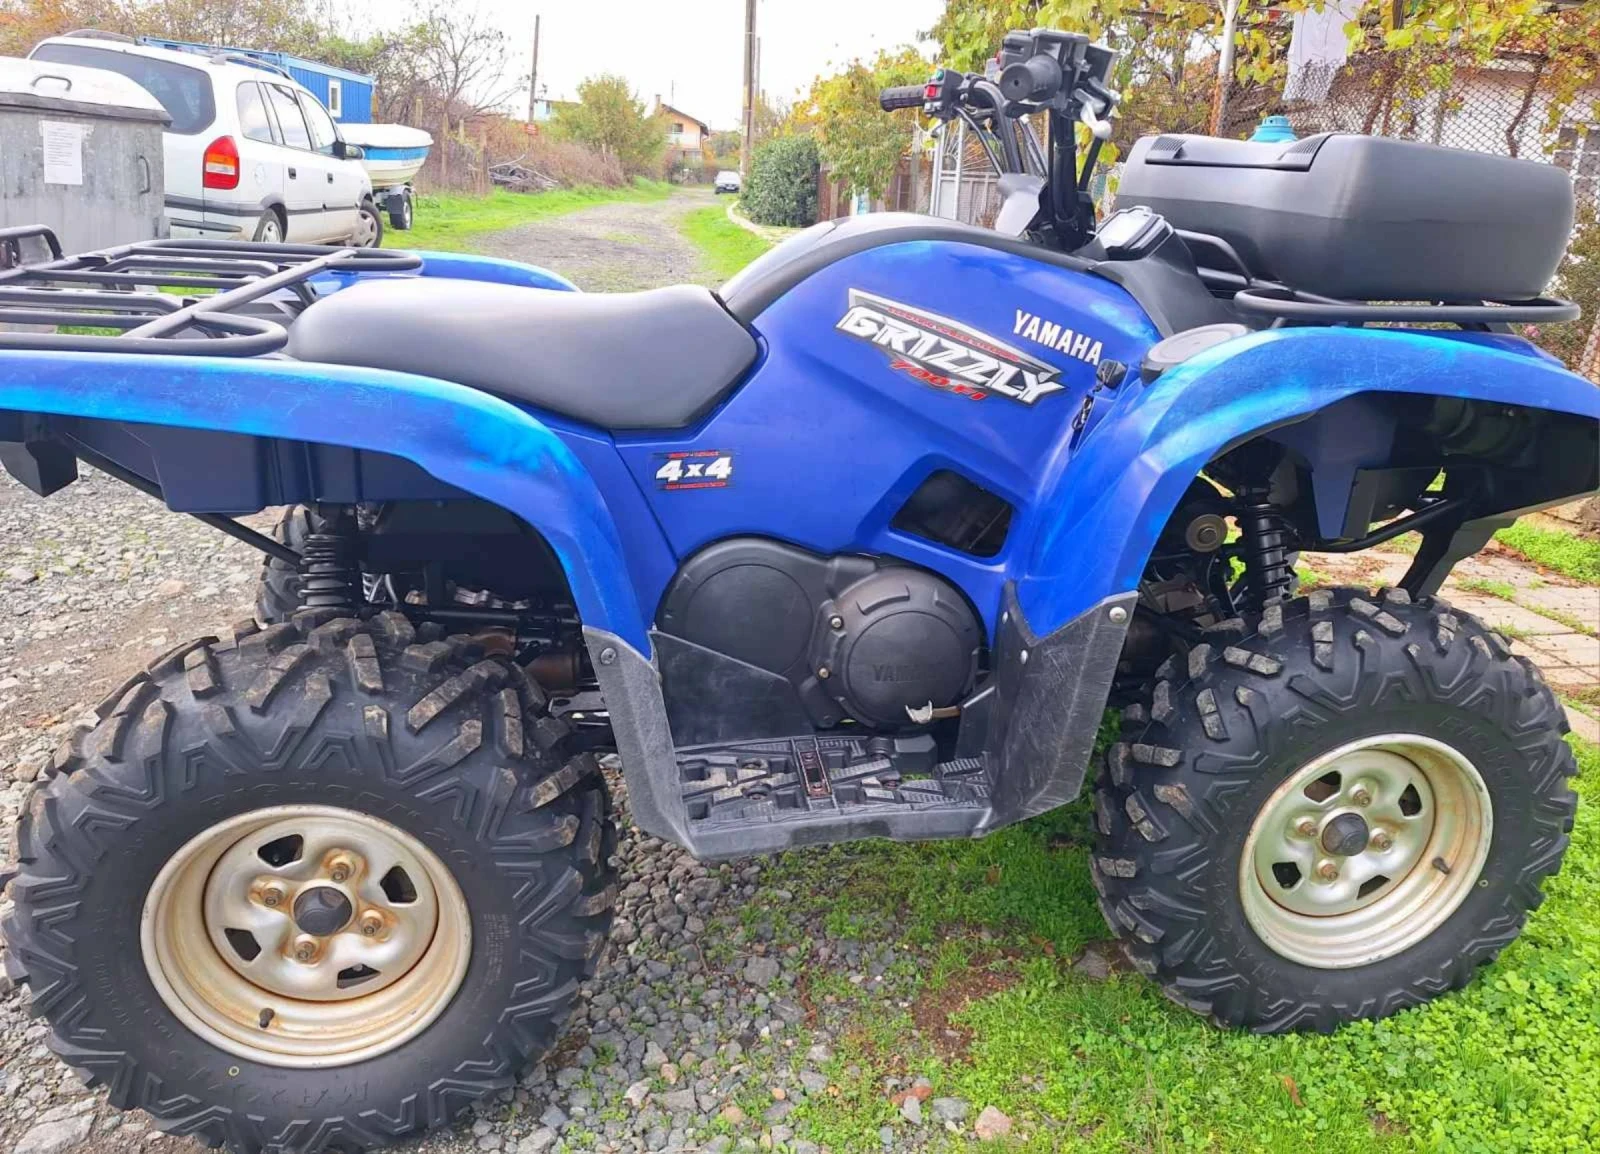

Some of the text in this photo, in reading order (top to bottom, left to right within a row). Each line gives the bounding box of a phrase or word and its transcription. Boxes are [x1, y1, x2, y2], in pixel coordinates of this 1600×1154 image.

[835, 305, 1066, 404] GRIZZLY
[1013, 309, 1103, 366] YAMAHA
[656, 456, 733, 483] 4x4
